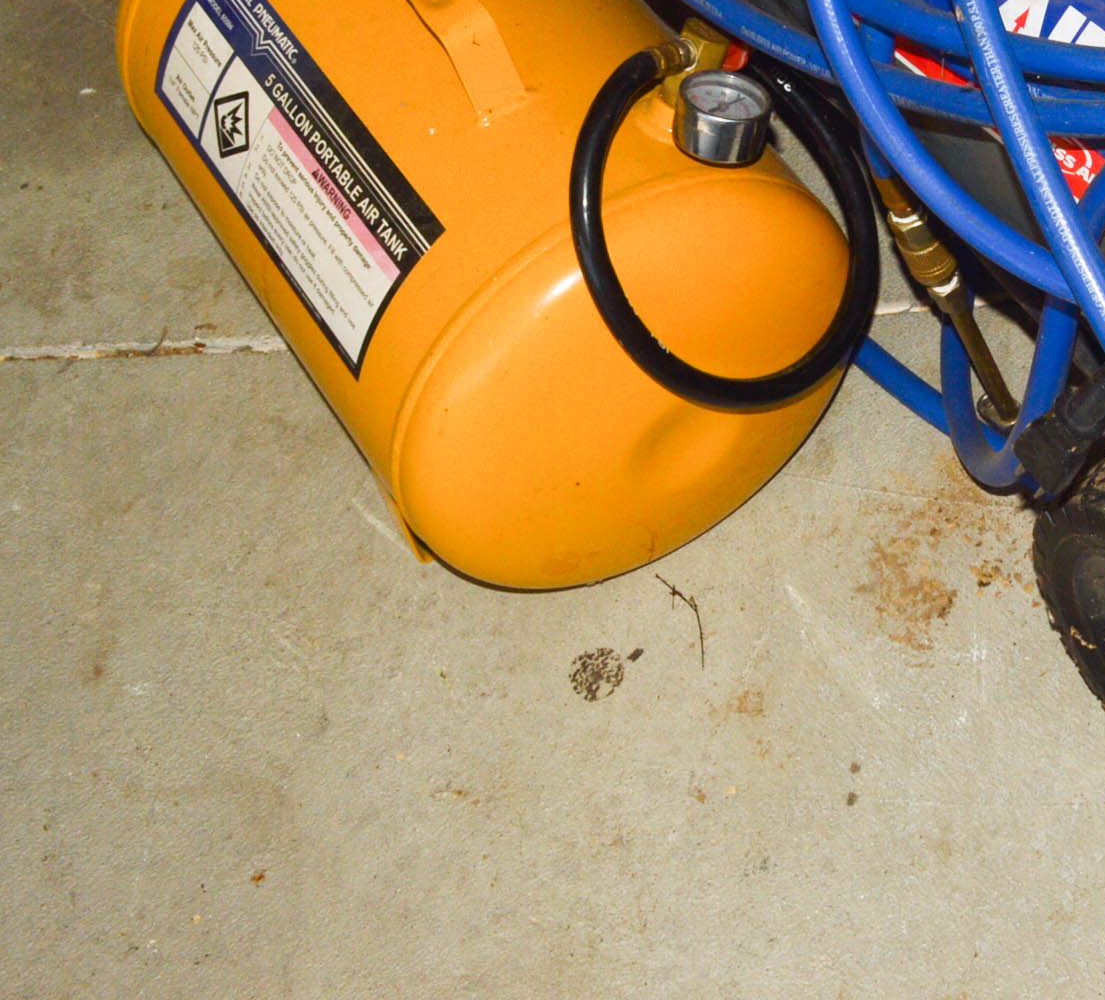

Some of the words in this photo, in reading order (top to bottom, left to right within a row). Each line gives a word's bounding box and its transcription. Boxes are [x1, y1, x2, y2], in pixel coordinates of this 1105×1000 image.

[977, 34, 998, 67] THAN
[262, 73, 278, 88] 5
[989, 65, 1017, 115] GREATER
[268, 81, 315, 137] GALLON
[1007, 110, 1042, 171] PRESSURES
[305, 131, 364, 203] PORTABLE
[314, 173, 353, 220] WARNING
[355, 196, 382, 225] AIR
[372, 218, 410, 262] TANK
